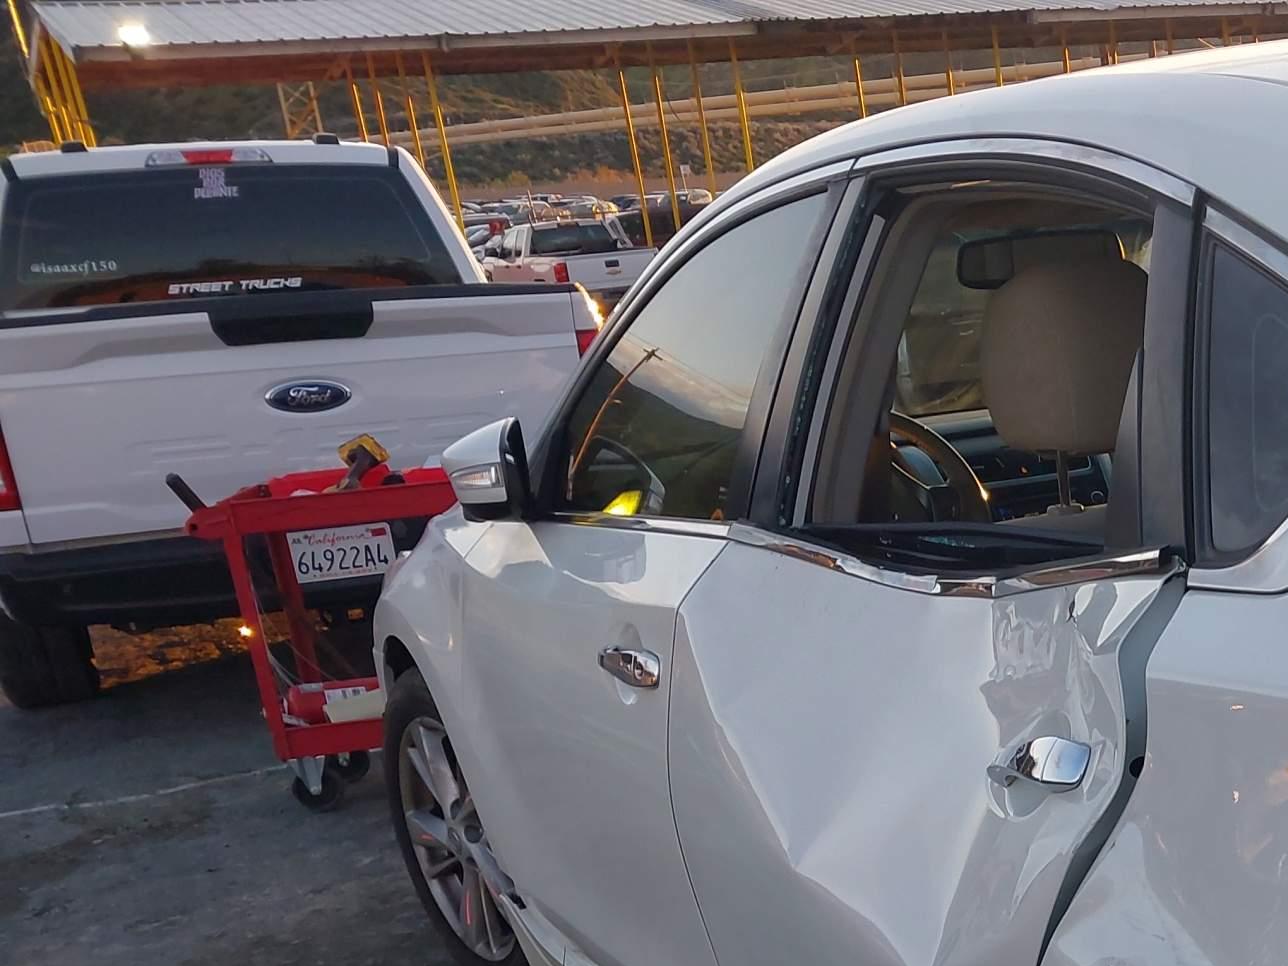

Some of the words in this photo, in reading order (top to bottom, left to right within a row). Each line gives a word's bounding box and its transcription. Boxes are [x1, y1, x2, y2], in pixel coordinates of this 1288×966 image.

[168, 281, 234, 295] STREET
[239, 277, 303, 290] TRUCKS
[288, 386, 332, 406] Ford
[307, 529, 367, 547] California
[298, 543, 389, 575] 64922A4
